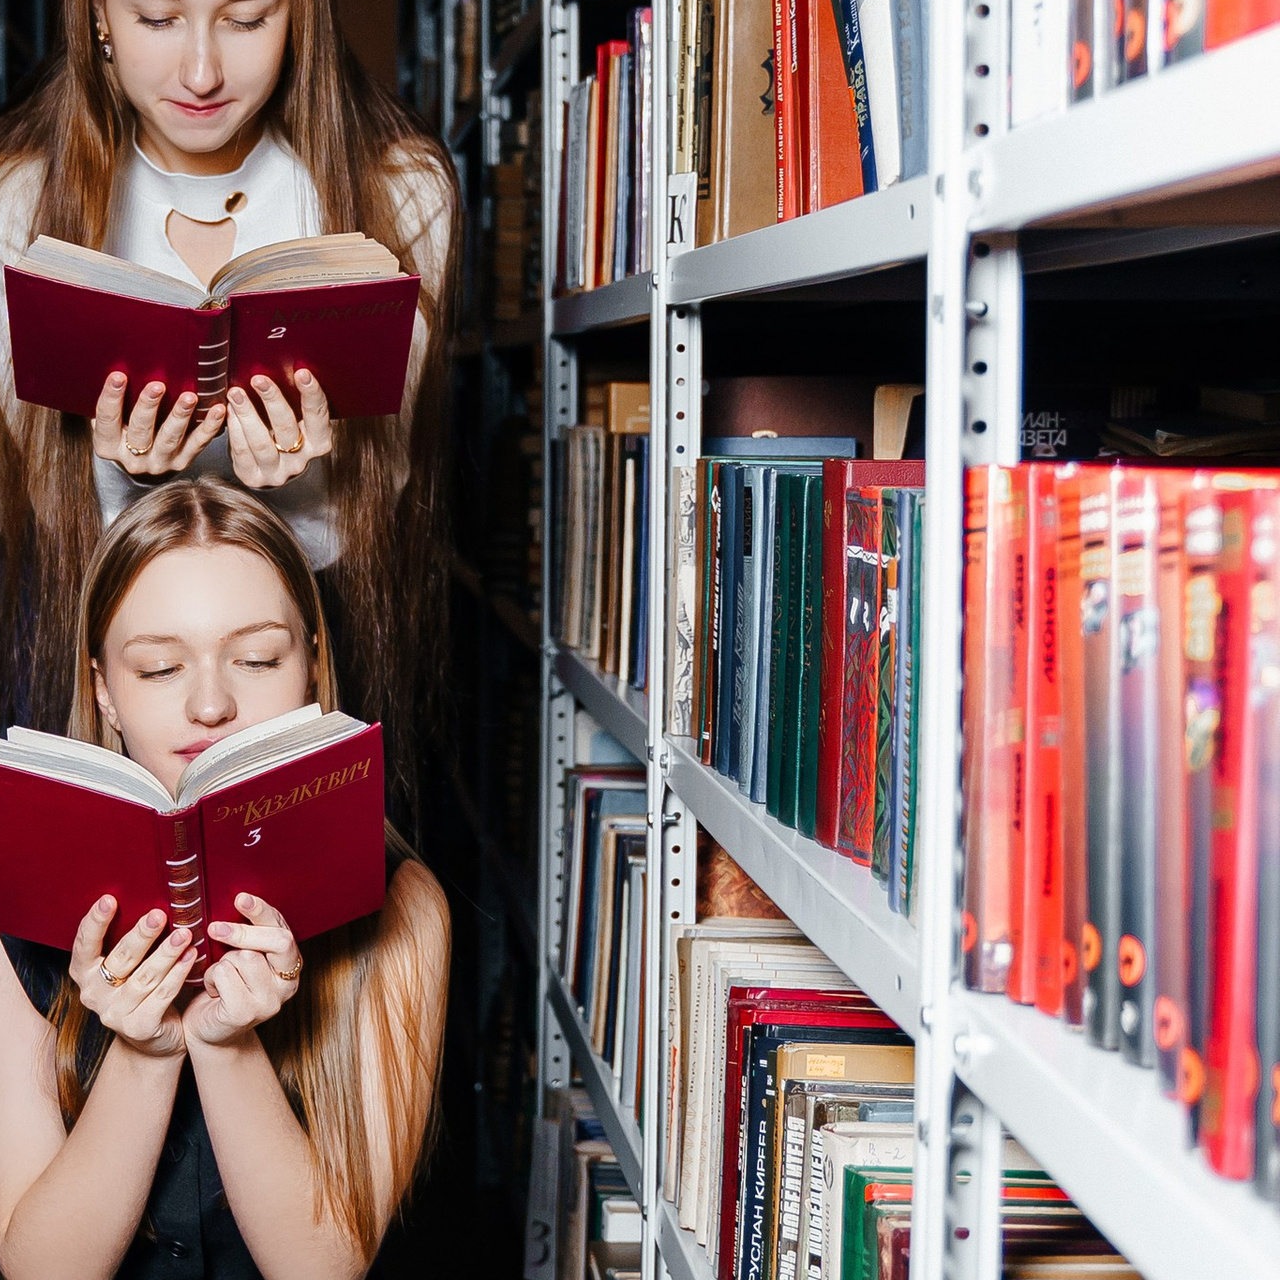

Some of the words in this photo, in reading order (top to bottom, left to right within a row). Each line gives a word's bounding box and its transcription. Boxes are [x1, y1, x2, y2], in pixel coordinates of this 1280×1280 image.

[775, 30, 784, 102] ДВУХЧАСОВАЯ
[854, 59, 869, 128] ТРАВА
[666, 193, 687, 245] К
[267, 326, 287, 340] 2
[243, 758, 372, 826] КАЗАКЕВИЧ
[244, 826, 262, 848] 3
[753, 1120, 767, 1200] КИРЕЕВ
[780, 1114, 806, 1242] ПОБЕДИТЕЛЯ
[807, 1128, 825, 1258] ПОБЕДИТЕЛЯ
[731, 1223, 740, 1278] АНАТОЛИЙ
